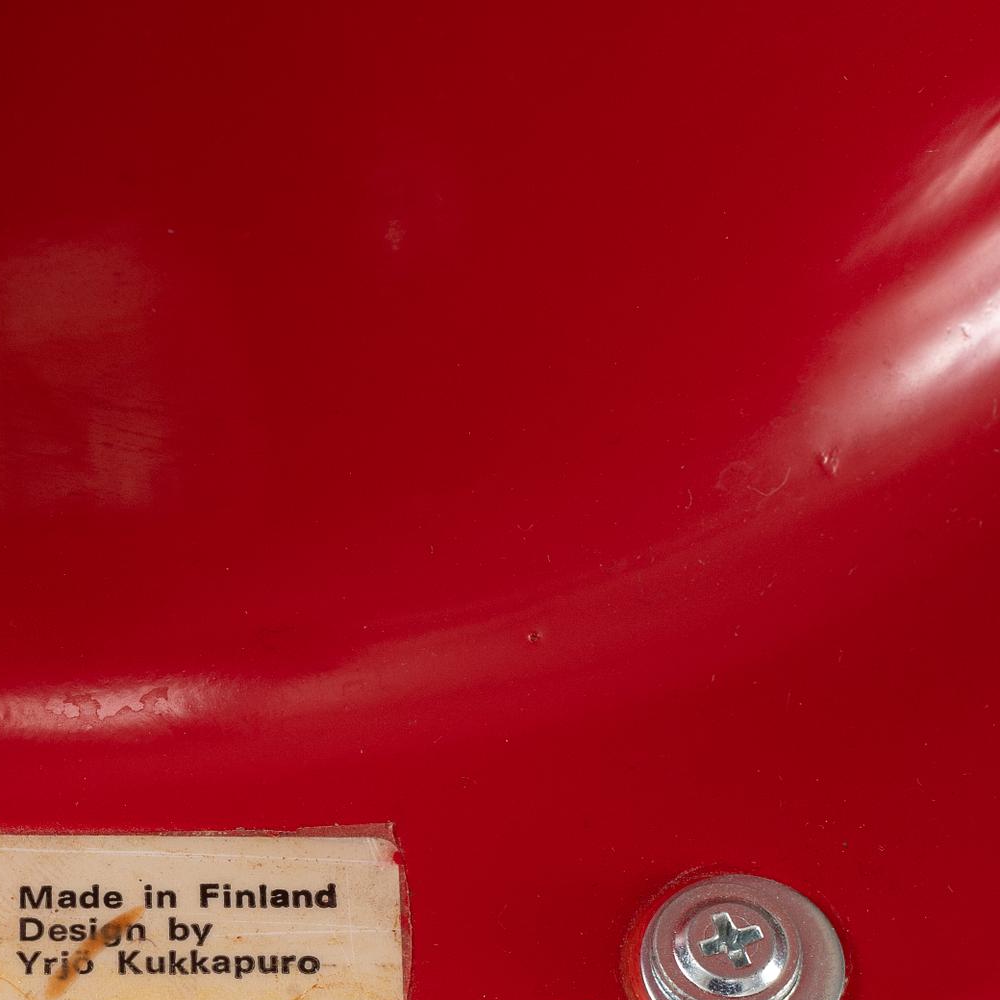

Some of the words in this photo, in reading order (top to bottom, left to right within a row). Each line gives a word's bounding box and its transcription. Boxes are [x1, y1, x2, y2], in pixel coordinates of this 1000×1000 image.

[19, 884, 123, 909] Made
[144, 884, 177, 909] in
[199, 882, 338, 909] Finland
[19, 917, 146, 948] Design
[168, 917, 213, 947] by
[16, 950, 94, 981] Yrjö
[118, 949, 321, 980] Kukkapuro
